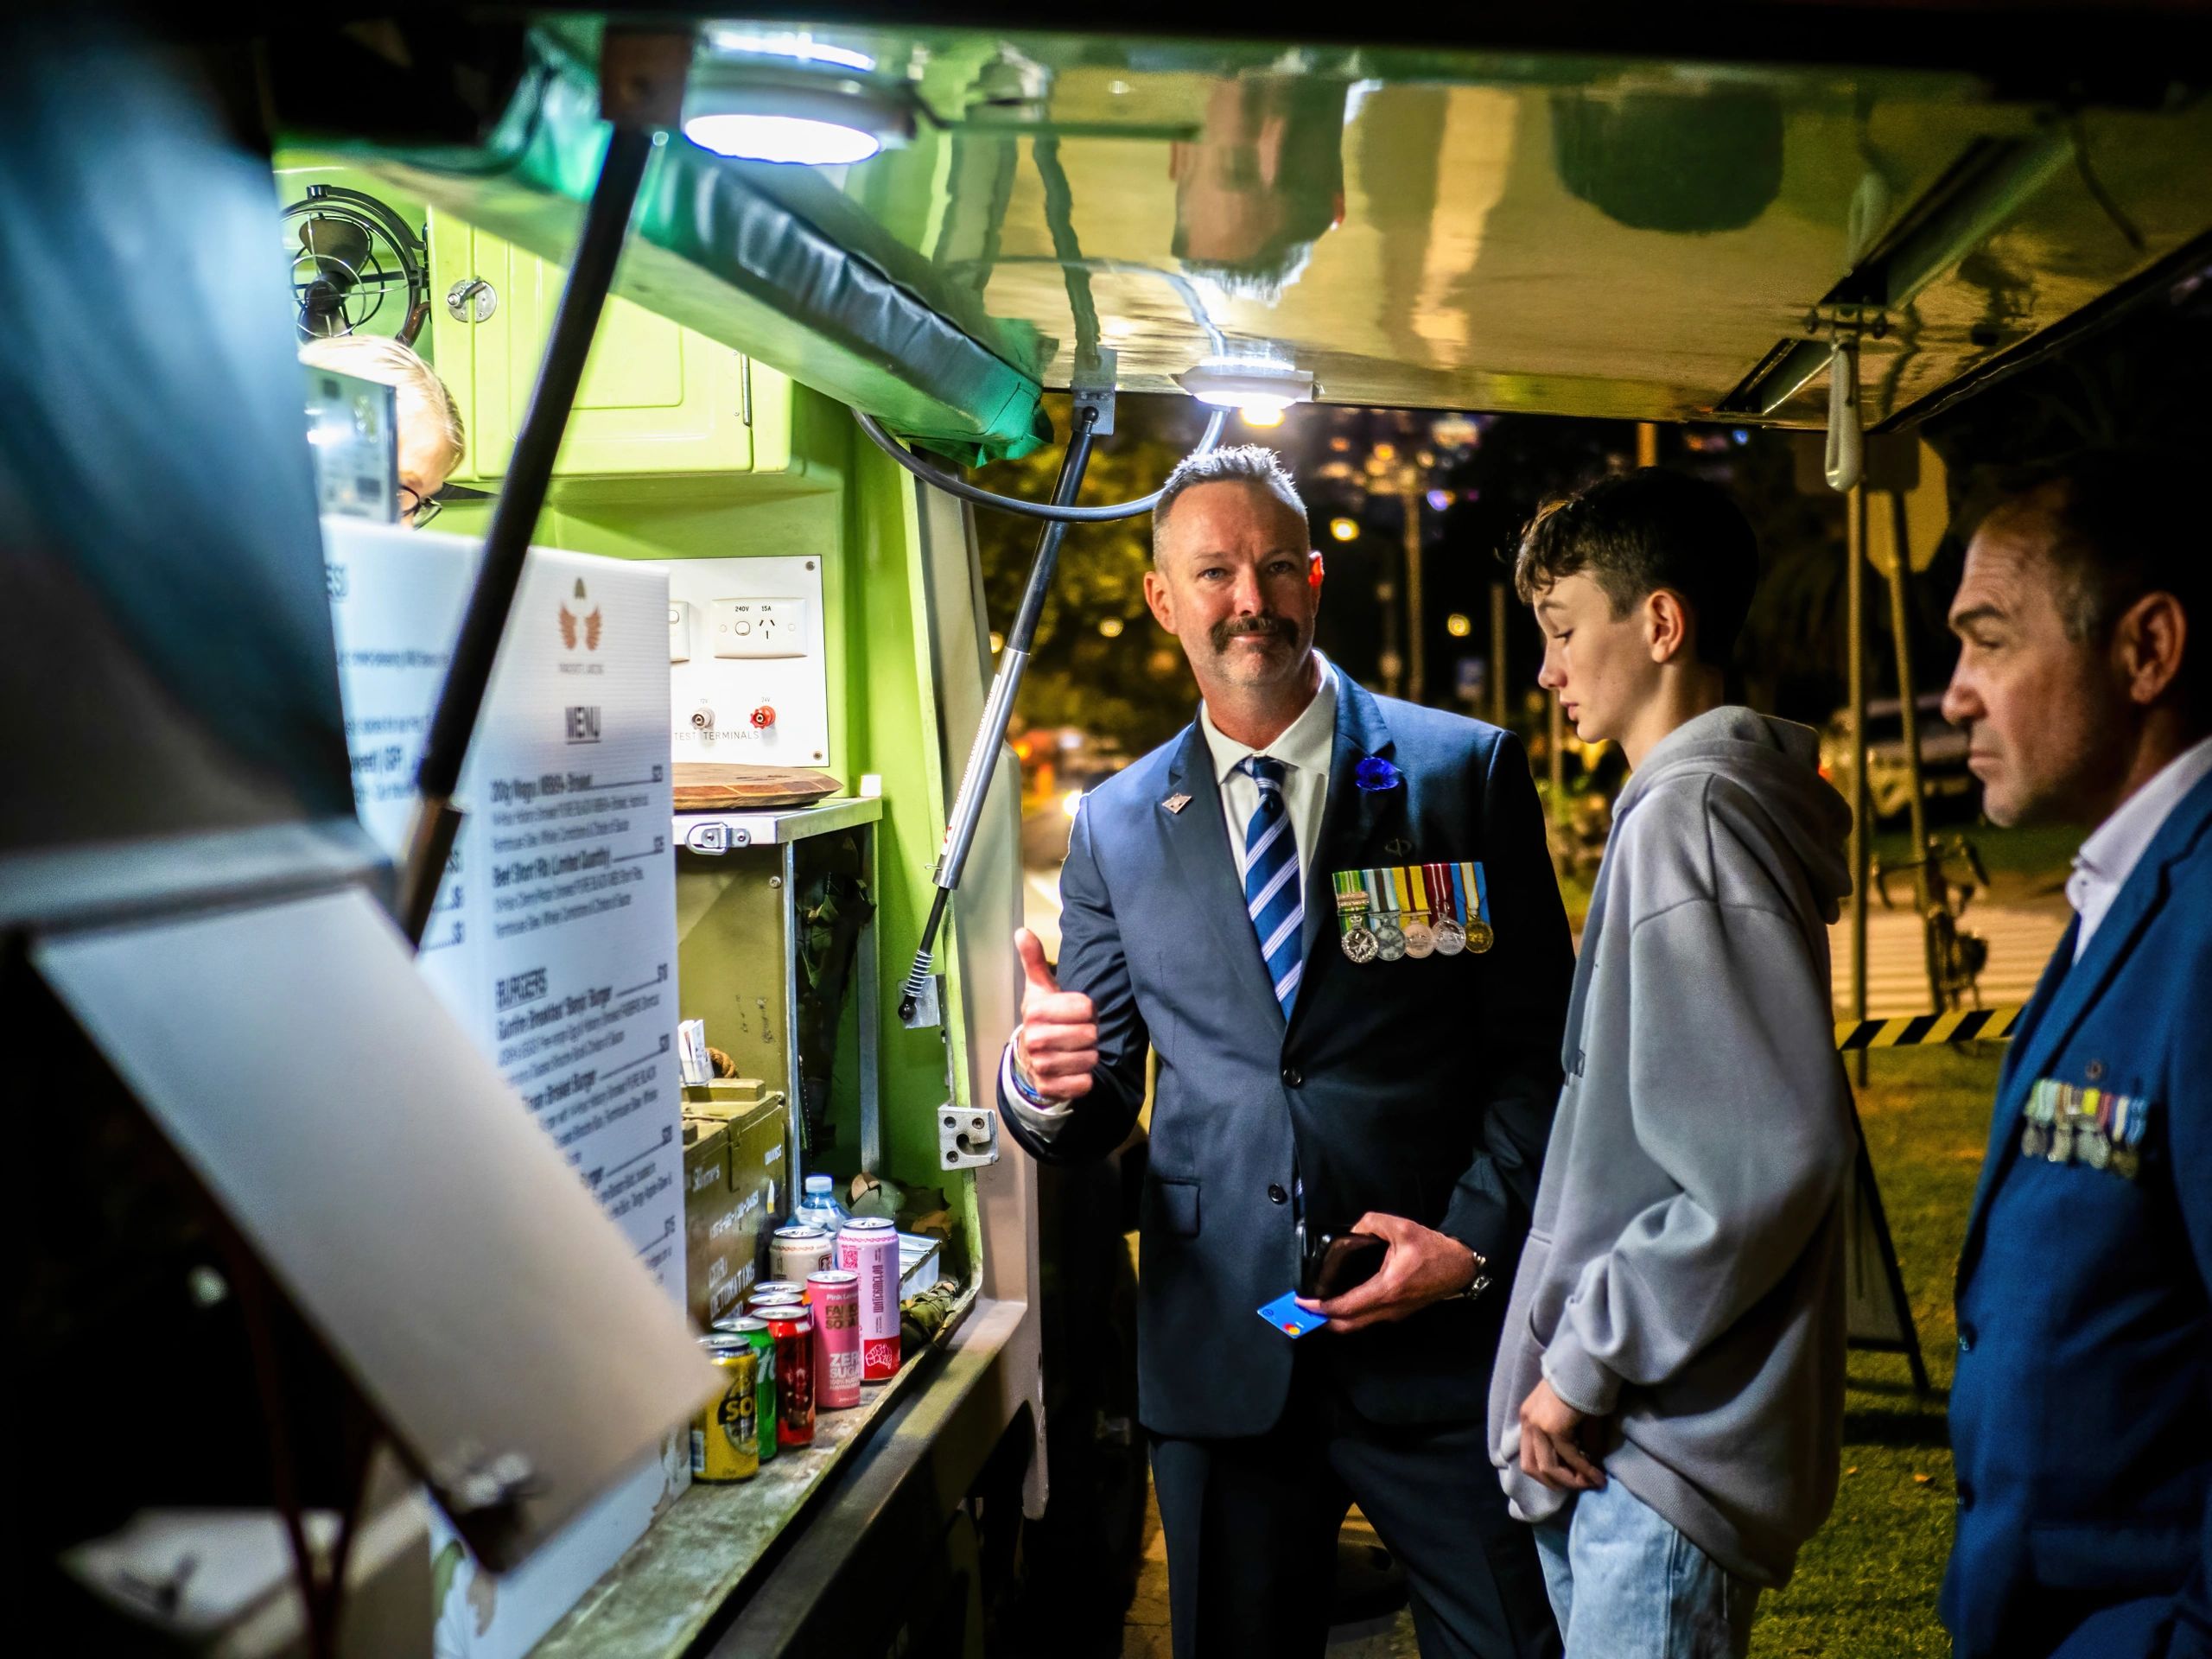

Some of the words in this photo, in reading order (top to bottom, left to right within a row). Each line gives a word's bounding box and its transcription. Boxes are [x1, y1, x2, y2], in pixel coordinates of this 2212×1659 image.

[566, 706, 601, 739] MENU
[674, 732, 696, 741] TEST
[703, 731, 760, 741] TERMINALS
[872, 1264, 884, 1313] WATERMELON
[830, 1351, 858, 1366] ZER
